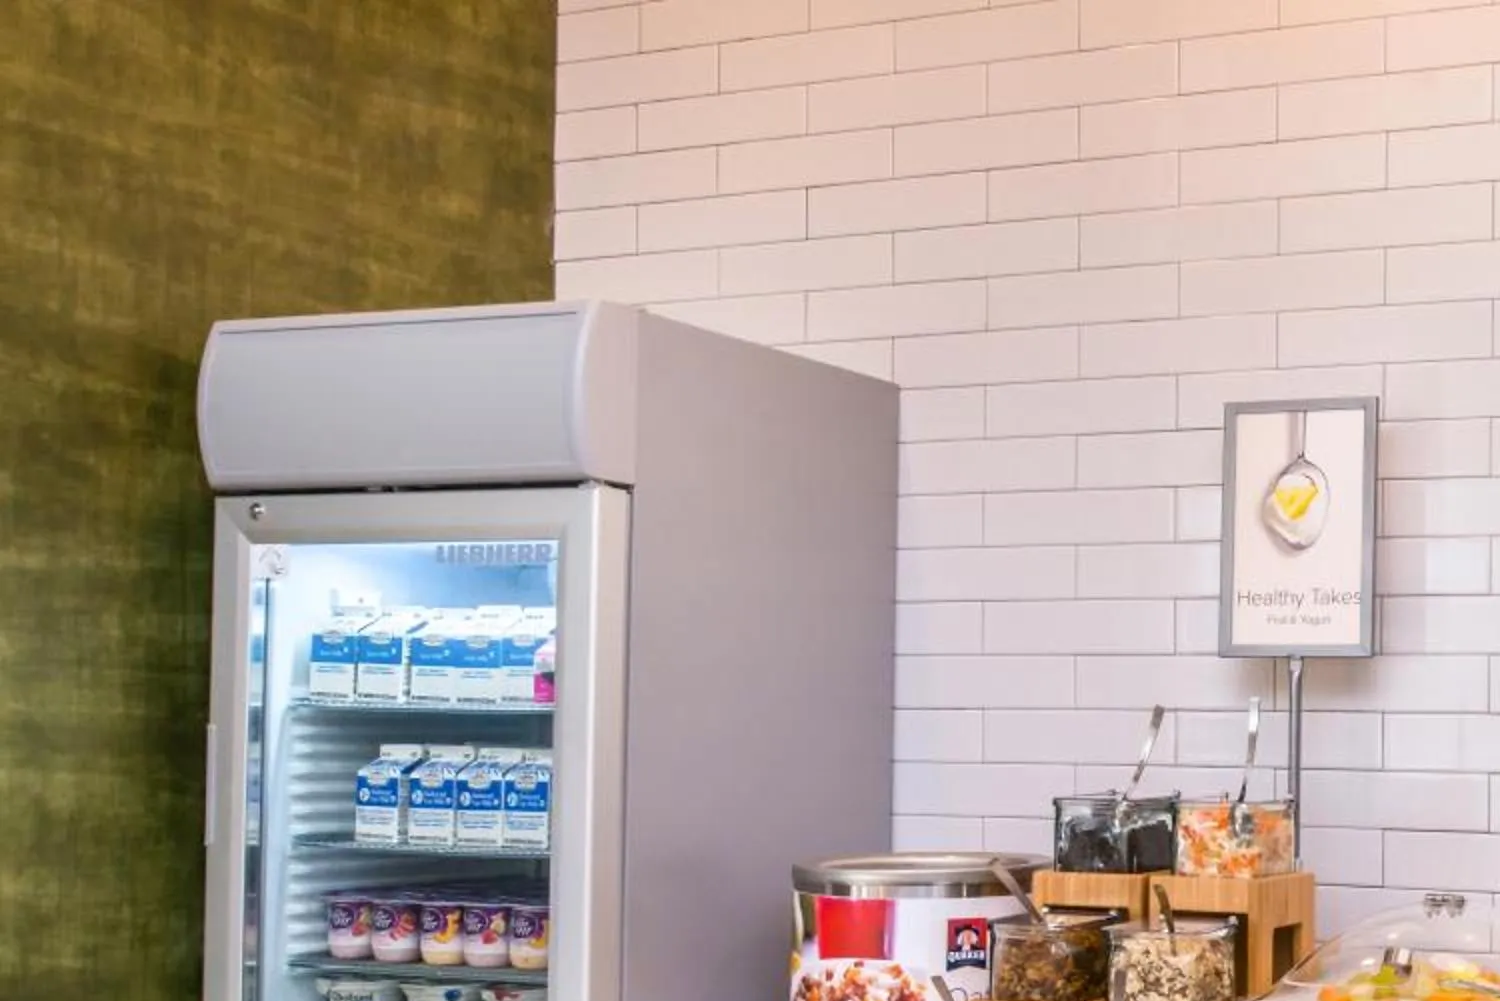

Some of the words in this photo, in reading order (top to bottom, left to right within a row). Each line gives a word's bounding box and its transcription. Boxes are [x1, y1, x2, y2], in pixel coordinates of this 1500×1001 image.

[436, 543, 553, 564] LIEBHERR
[1237, 589, 1305, 609] Healthy
[1311, 587, 1360, 606] Takes
